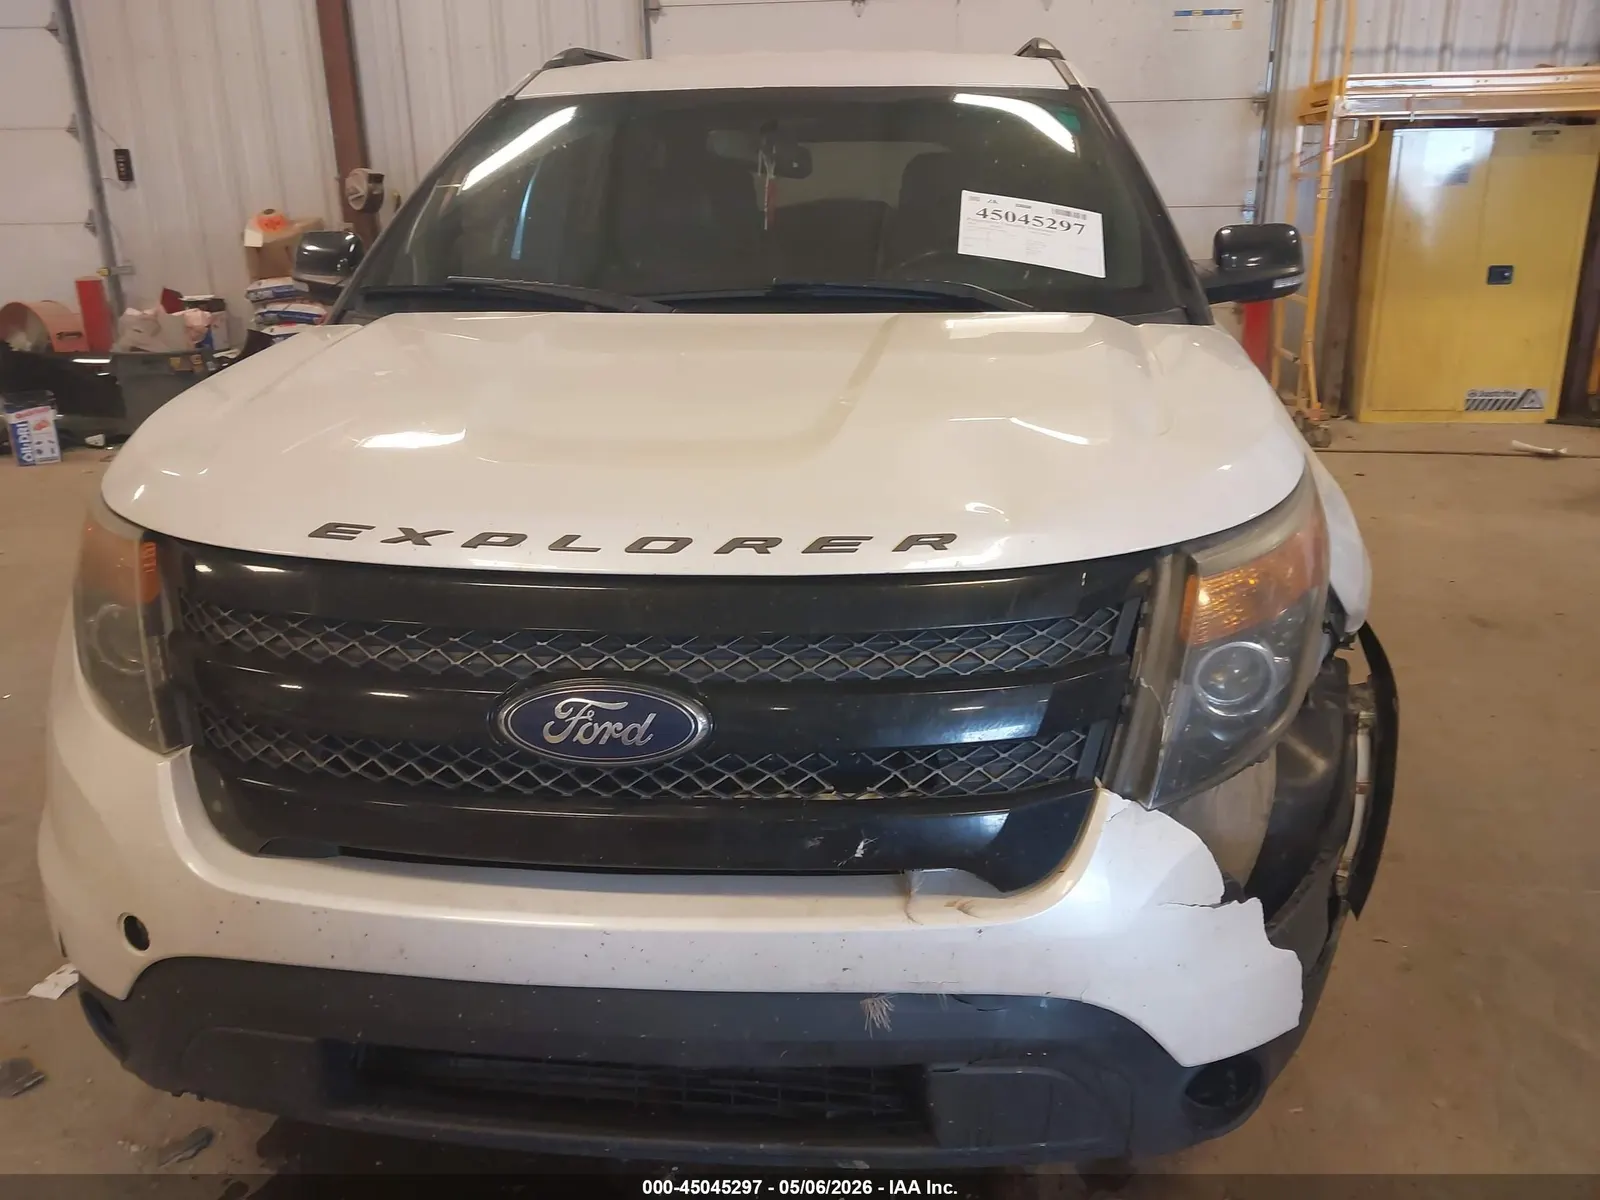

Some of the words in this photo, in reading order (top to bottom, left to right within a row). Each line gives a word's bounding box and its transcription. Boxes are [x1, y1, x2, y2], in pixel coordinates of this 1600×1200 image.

[976, 207, 1085, 235] 45045297
[308, 522, 958, 555] EXPLORER
[542, 697, 657, 746] Ford
